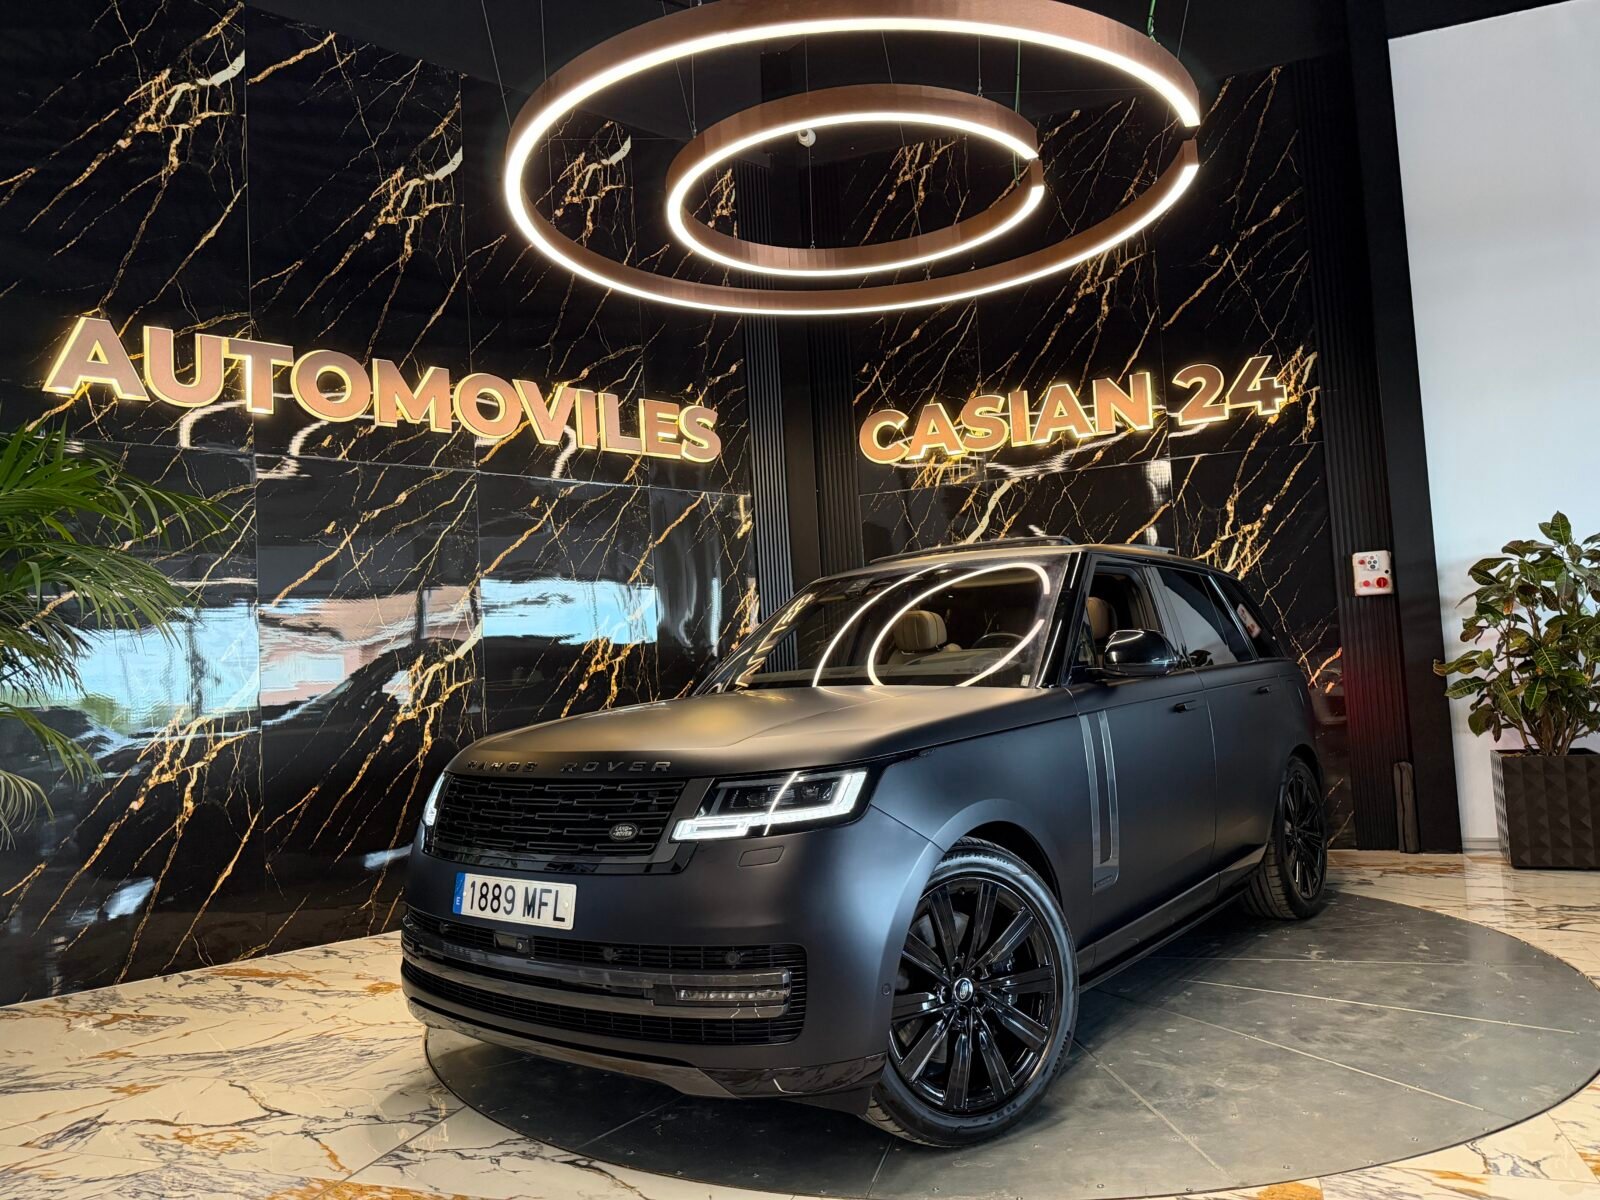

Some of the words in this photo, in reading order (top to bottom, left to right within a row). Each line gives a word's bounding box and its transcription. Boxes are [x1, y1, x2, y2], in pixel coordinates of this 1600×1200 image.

[42, 315, 723, 464] AUTOMOVILES
[858, 371, 1153, 464] CASIAN
[1170, 354, 1288, 426] 24
[561, 761, 672, 773] ROVER
[469, 880, 516, 916] 1889
[522, 886, 566, 922] MFL
